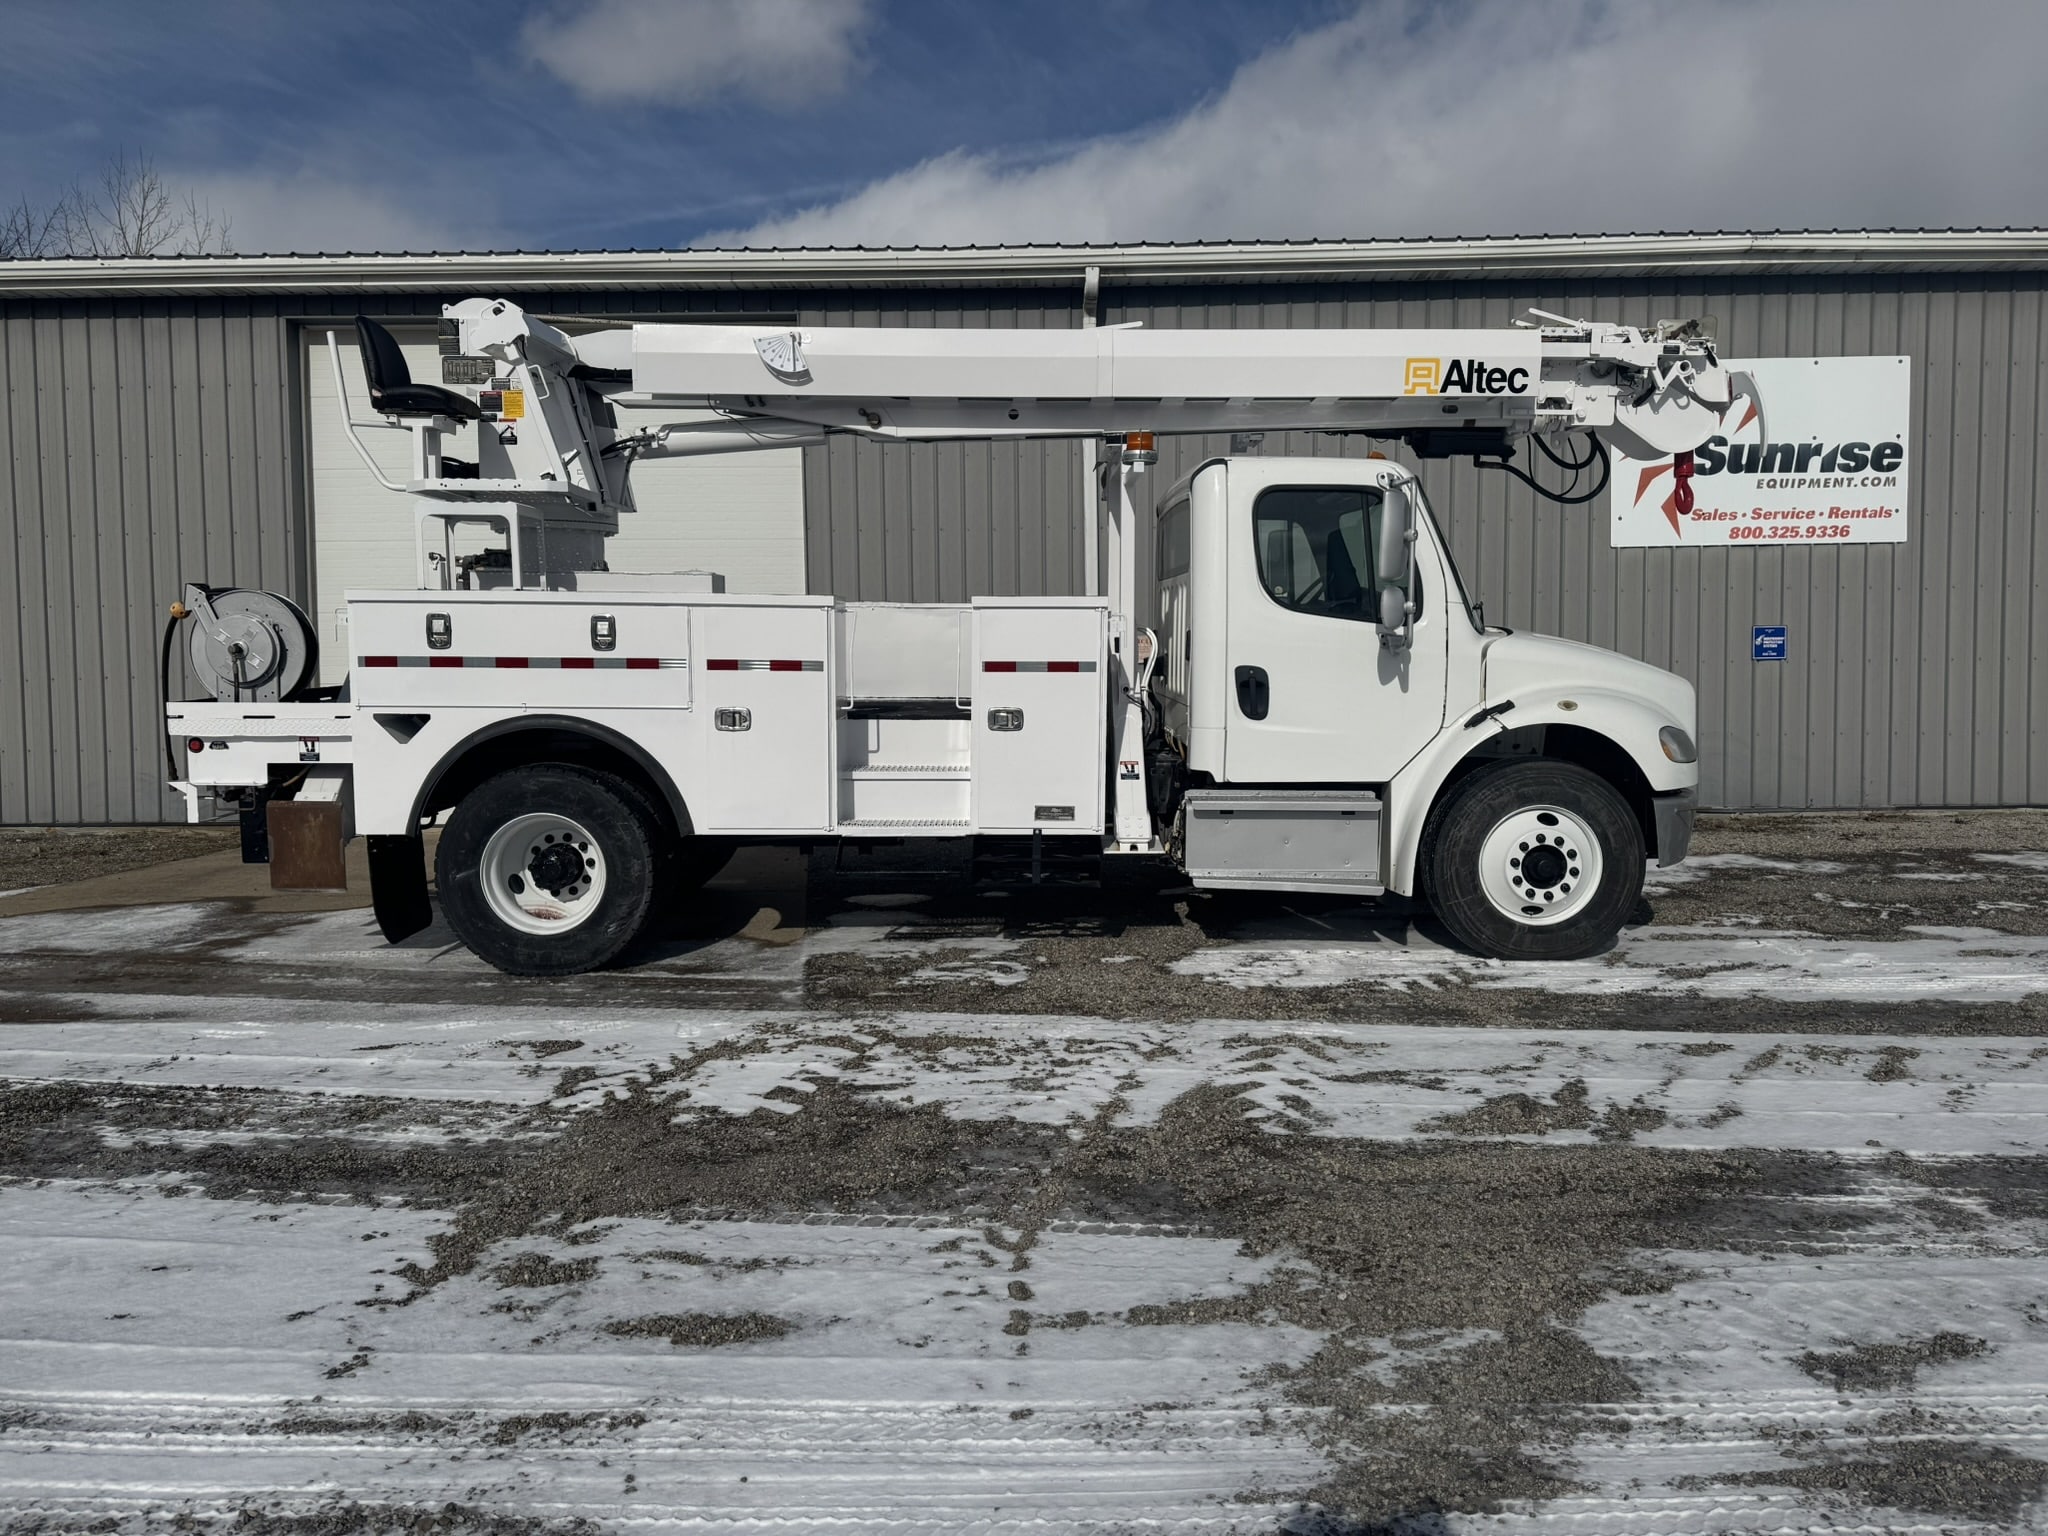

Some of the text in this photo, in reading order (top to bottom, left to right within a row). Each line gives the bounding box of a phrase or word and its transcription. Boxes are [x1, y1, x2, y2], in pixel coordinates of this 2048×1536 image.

[1440, 359, 1529, 394] Altec
[1694, 435, 1904, 476] Sunrise
[1756, 476, 1897, 490] EQUIPMENT.COM
[1691, 505, 1893, 522] Sales Service Rentals
[1729, 525, 1851, 540] 800.325.9336
